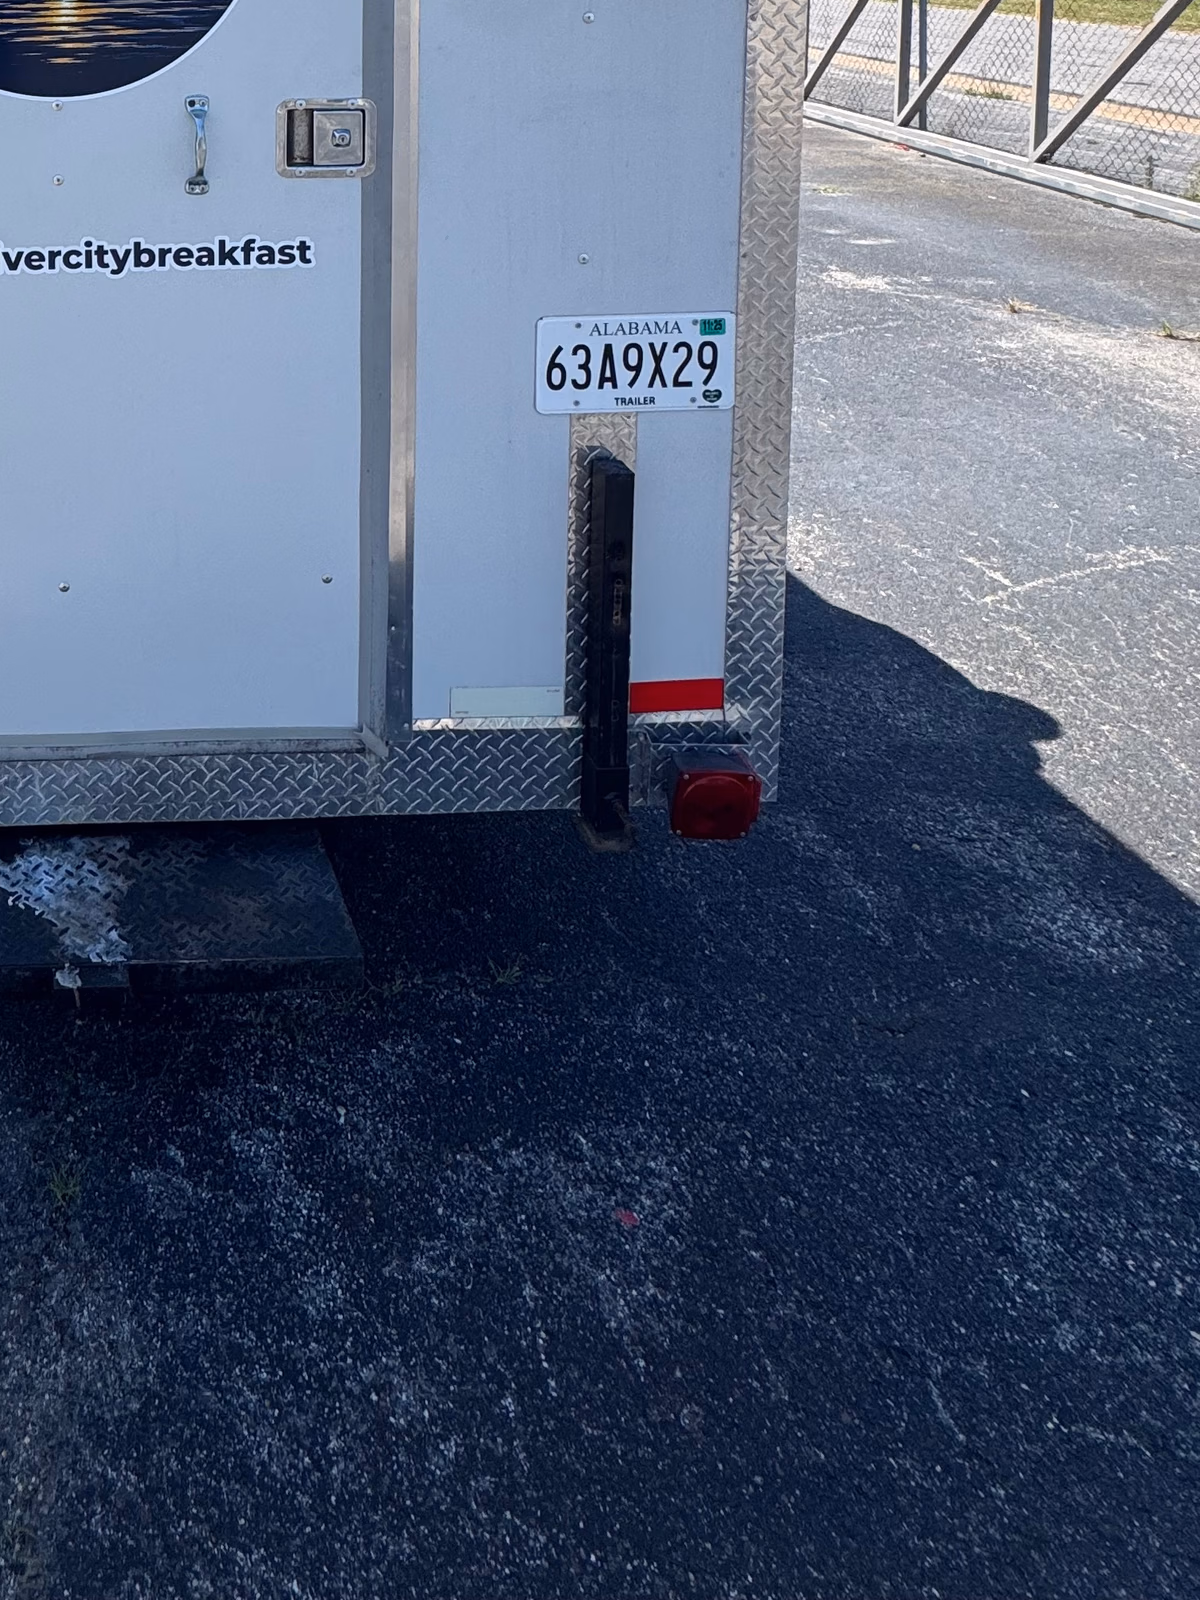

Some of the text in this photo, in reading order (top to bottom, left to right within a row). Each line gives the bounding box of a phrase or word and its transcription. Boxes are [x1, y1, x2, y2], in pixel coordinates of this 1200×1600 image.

[589, 320, 683, 337] ALABAMA
[546, 340, 718, 391] 63A9X29
[614, 396, 656, 406] TRAILER
